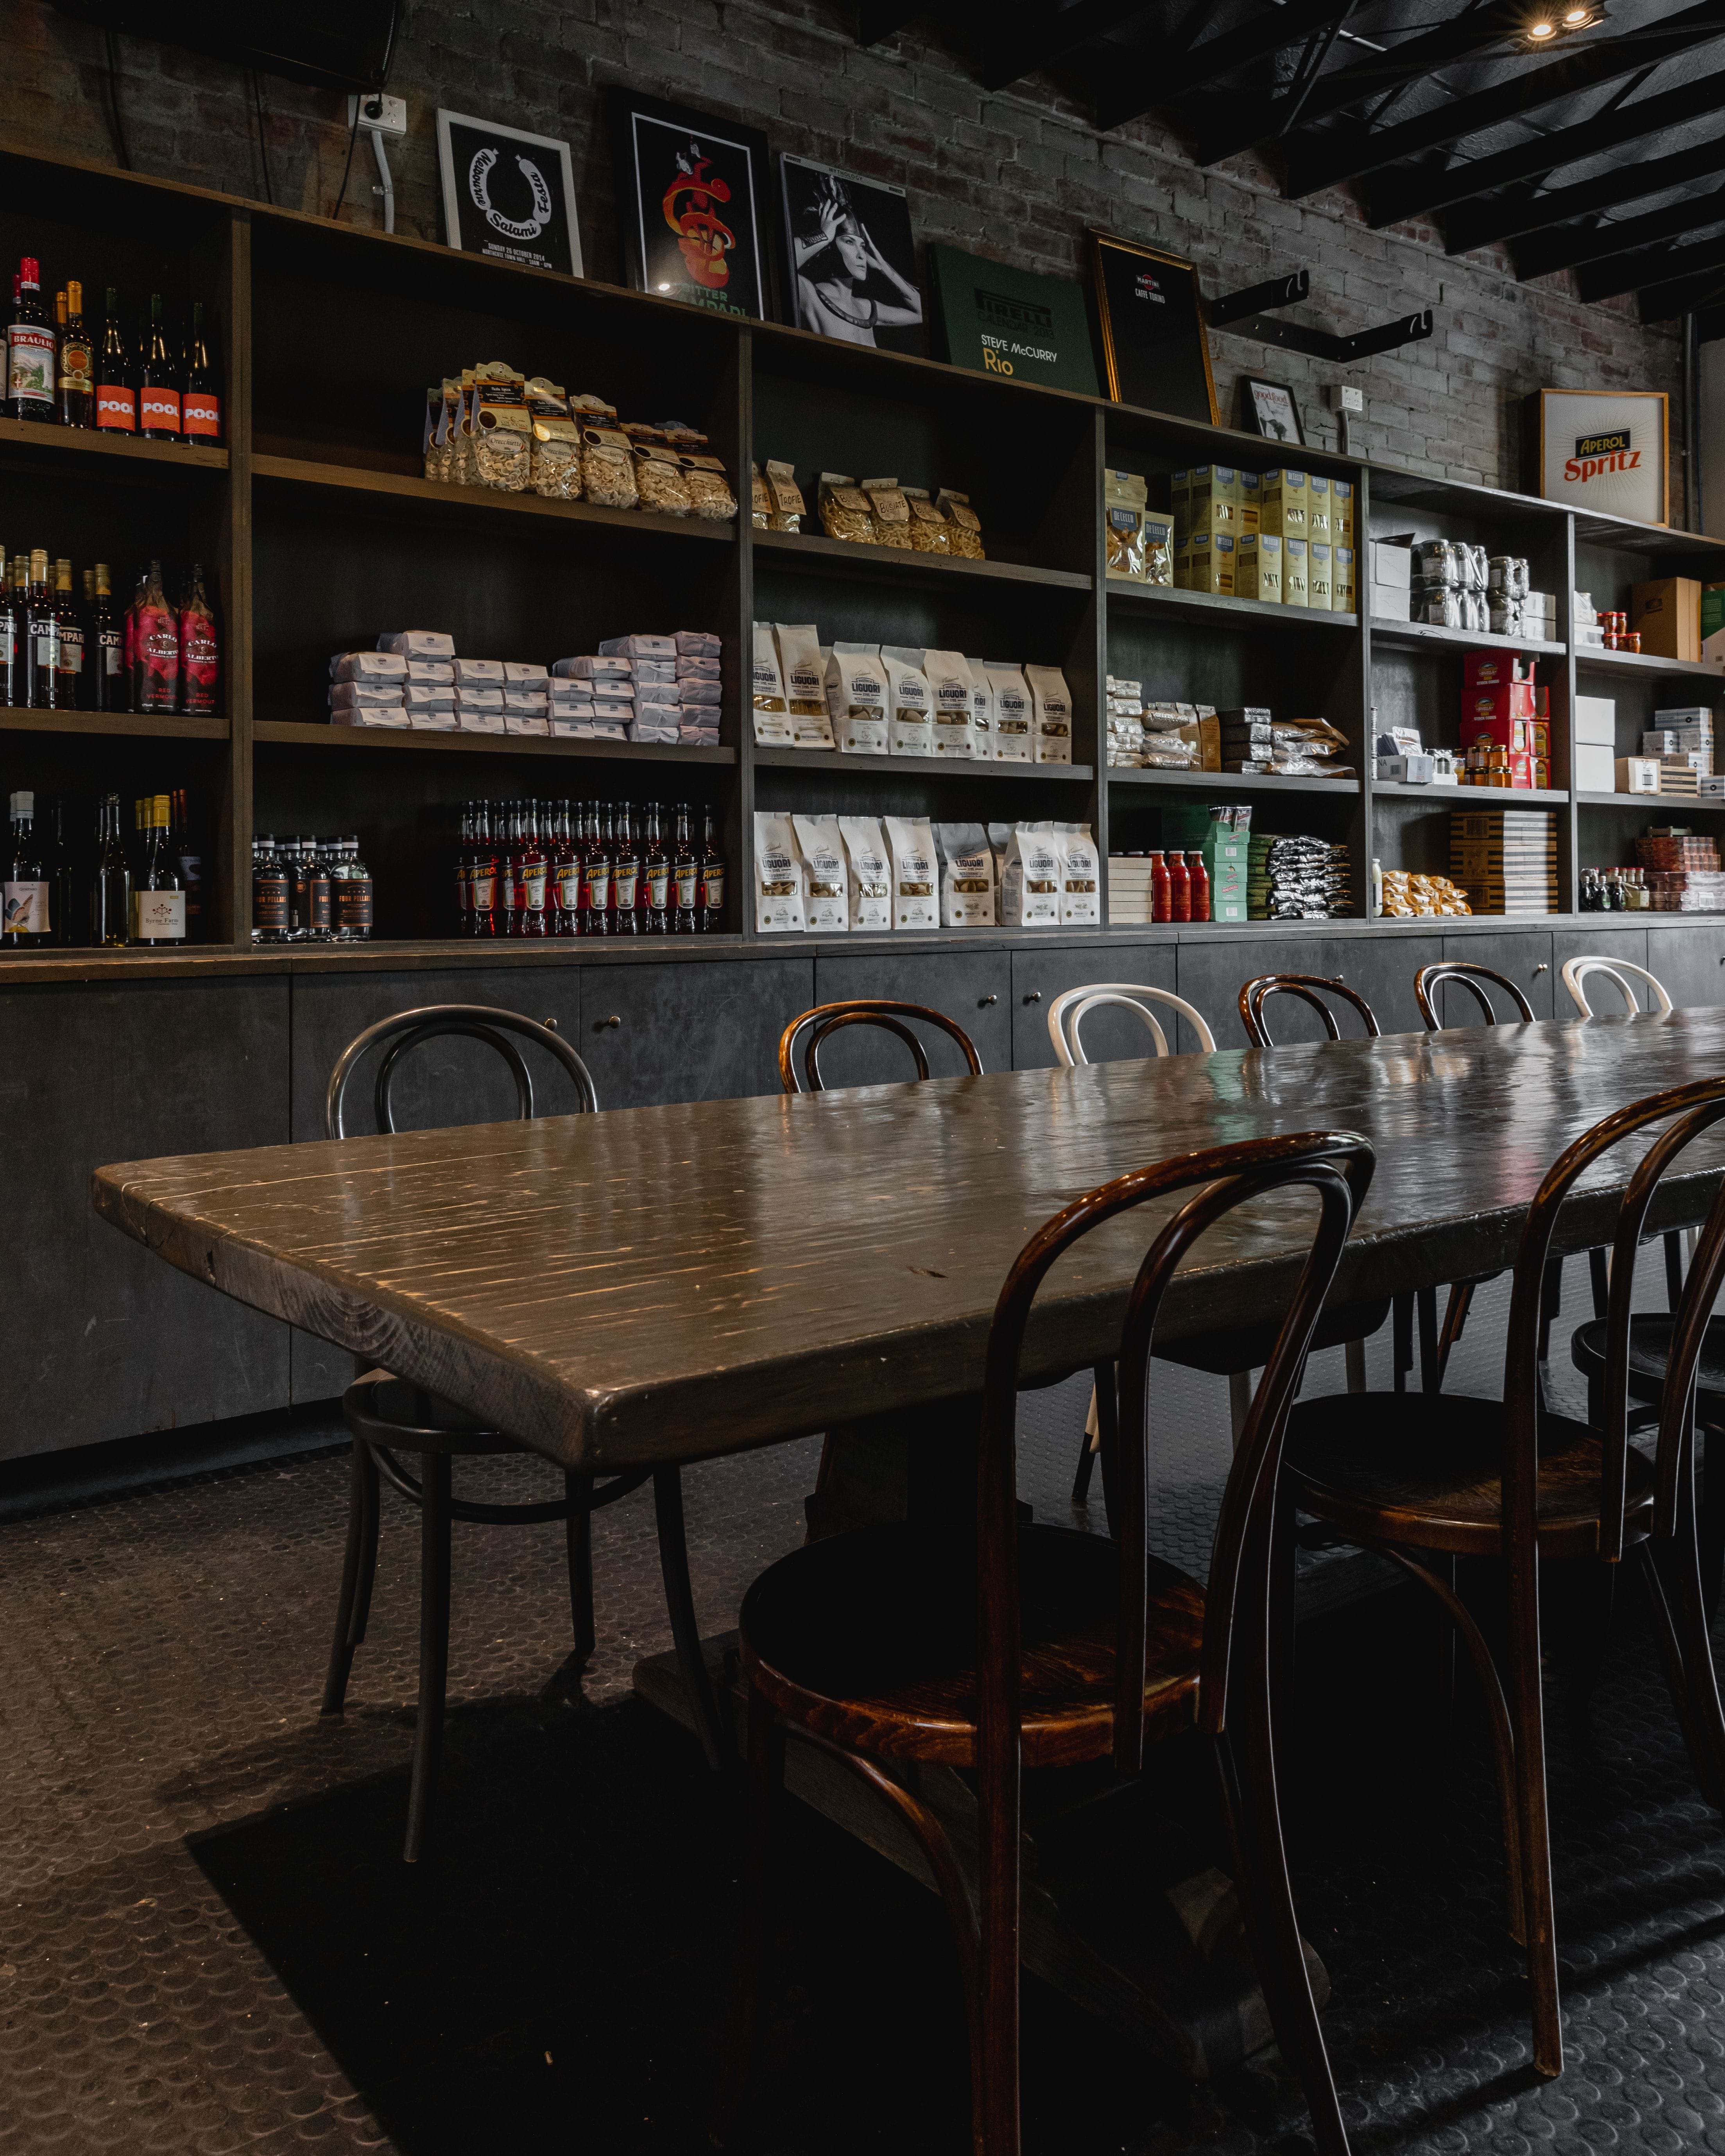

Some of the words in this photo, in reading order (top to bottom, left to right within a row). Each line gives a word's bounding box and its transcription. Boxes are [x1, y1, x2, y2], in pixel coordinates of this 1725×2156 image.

[471, 152, 491, 206] Melbourne
[829, 167, 862, 180] MYTHOLOGY
[530, 172, 549, 214] Festa
[490, 213, 537, 237] Salami
[488, 243, 505, 252] SUNDAY
[513, 249, 532, 258] OCTOBER
[533, 253, 545, 261] 2014
[1137, 277, 1159, 288] MARTINI
[981, 335, 1008, 351] STEVE
[1011, 343, 1057, 362] McCURRY
[983, 347, 1013, 375] Rio
[99, 401, 134, 415] POOL
[143, 403, 178, 417] POOL
[185, 408, 220, 422] POOL
[491, 438, 521, 446] Orecchiette
[1580, 436, 1626, 454] APEROL
[1564, 450, 1641, 482] Spritz
[779, 493, 801, 506] TROFIE
[880, 500, 906, 513] BUSIATE
[59, 632, 84, 643] MPARI
[149, 634, 177, 642] CARLO
[188, 639, 217, 648] CARLO
[753, 672, 776, 682] IGUORI
[791, 675, 819, 685] LIGUORI
[852, 683, 880, 693] LIGUORI
[899, 686, 924, 697] LIGUORI
[939, 689, 966, 698] LIGUORI
[1000, 700, 1024, 709] LIGUORI
[1044, 704, 1065, 712] LIGUORI
[762, 859, 791, 868] LIGUORI
[813, 860, 839, 868] LIGUORI
[860, 861, 883, 870] LIGUORI
[902, 861, 928, 870] LIGUORI
[955, 859, 983, 867] LIGUORI
[470, 867, 497, 879] APEROL
[502, 869, 513, 878] APE
[612, 866, 638, 879] APEROL
[703, 867, 724, 879] APERO
